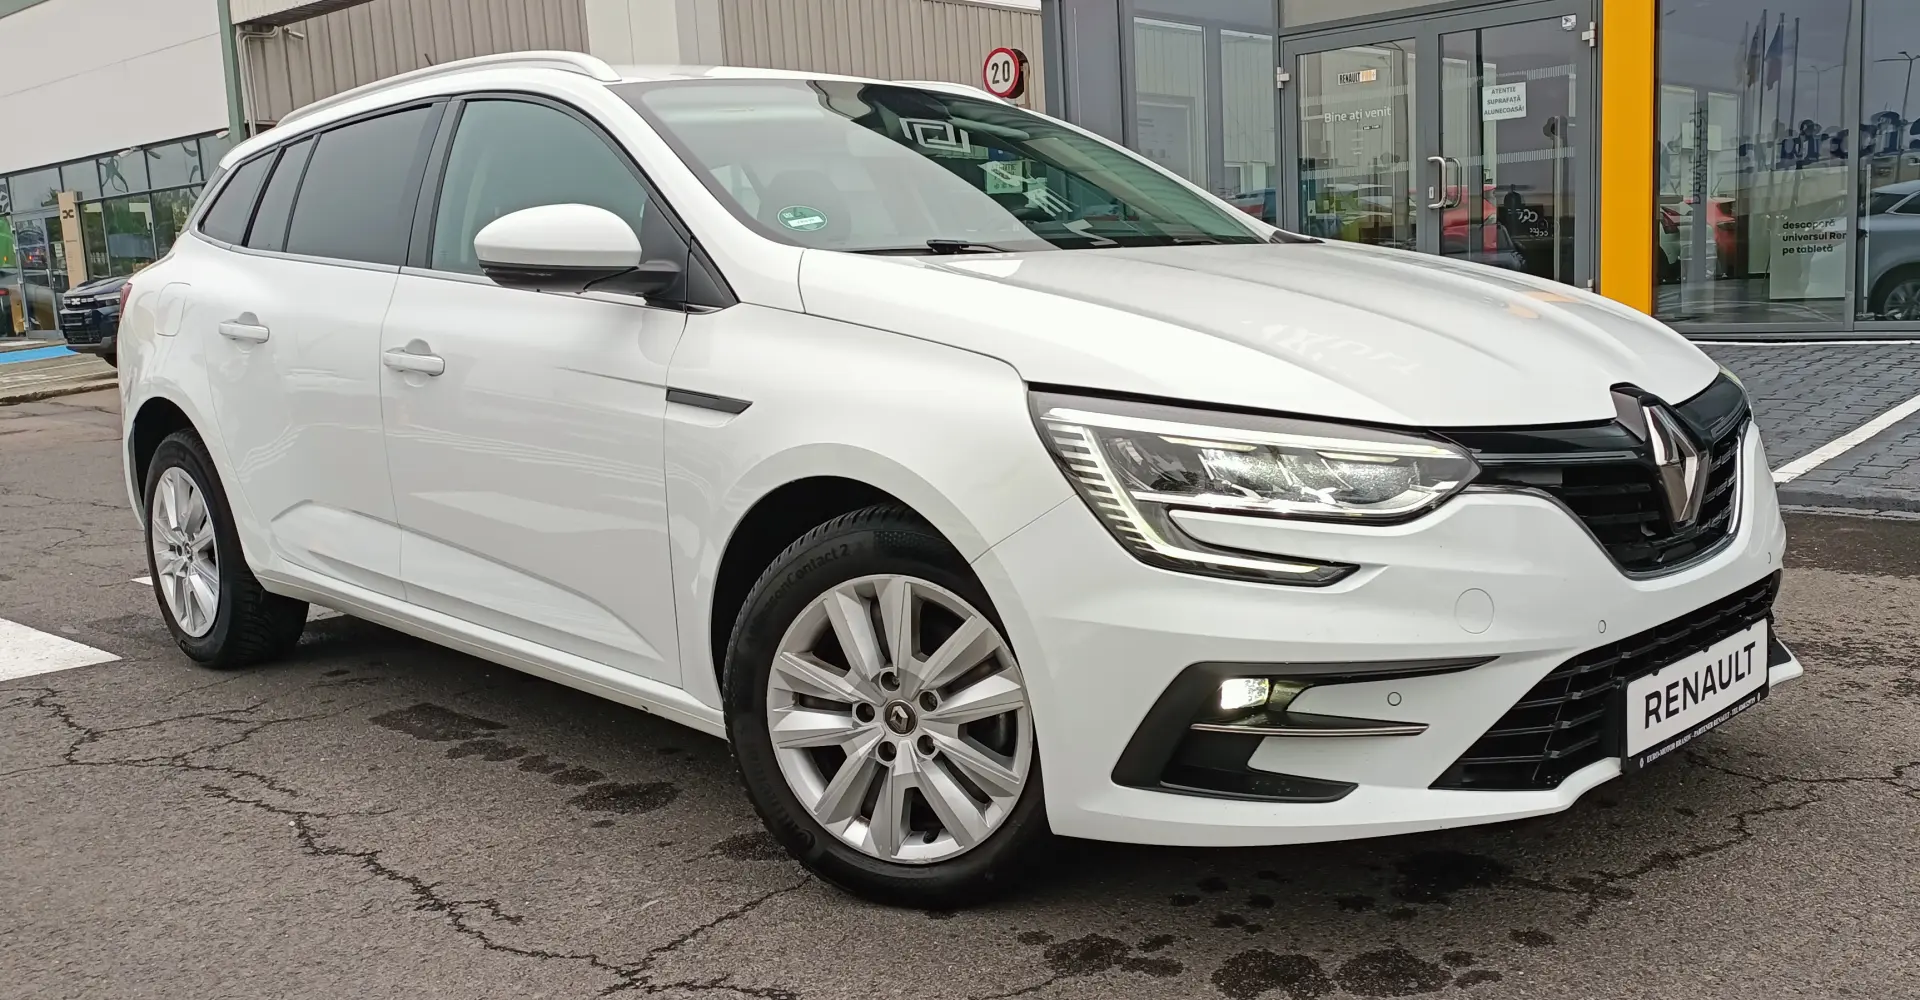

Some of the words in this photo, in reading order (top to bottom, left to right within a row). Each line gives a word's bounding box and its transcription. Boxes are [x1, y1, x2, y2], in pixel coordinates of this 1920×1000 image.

[991, 60, 1010, 84] 20
[1339, 71, 1360, 84] RENAULT
[1324, 112, 1347, 123] Bine
[1365, 106, 1391, 118] venit
[1782, 231, 1827, 242] universul
[1782, 246, 1795, 256] pe
[1796, 244, 1834, 254] tabletă
[838, 543, 852, 558] 2
[1644, 641, 1756, 730] RENAULT
